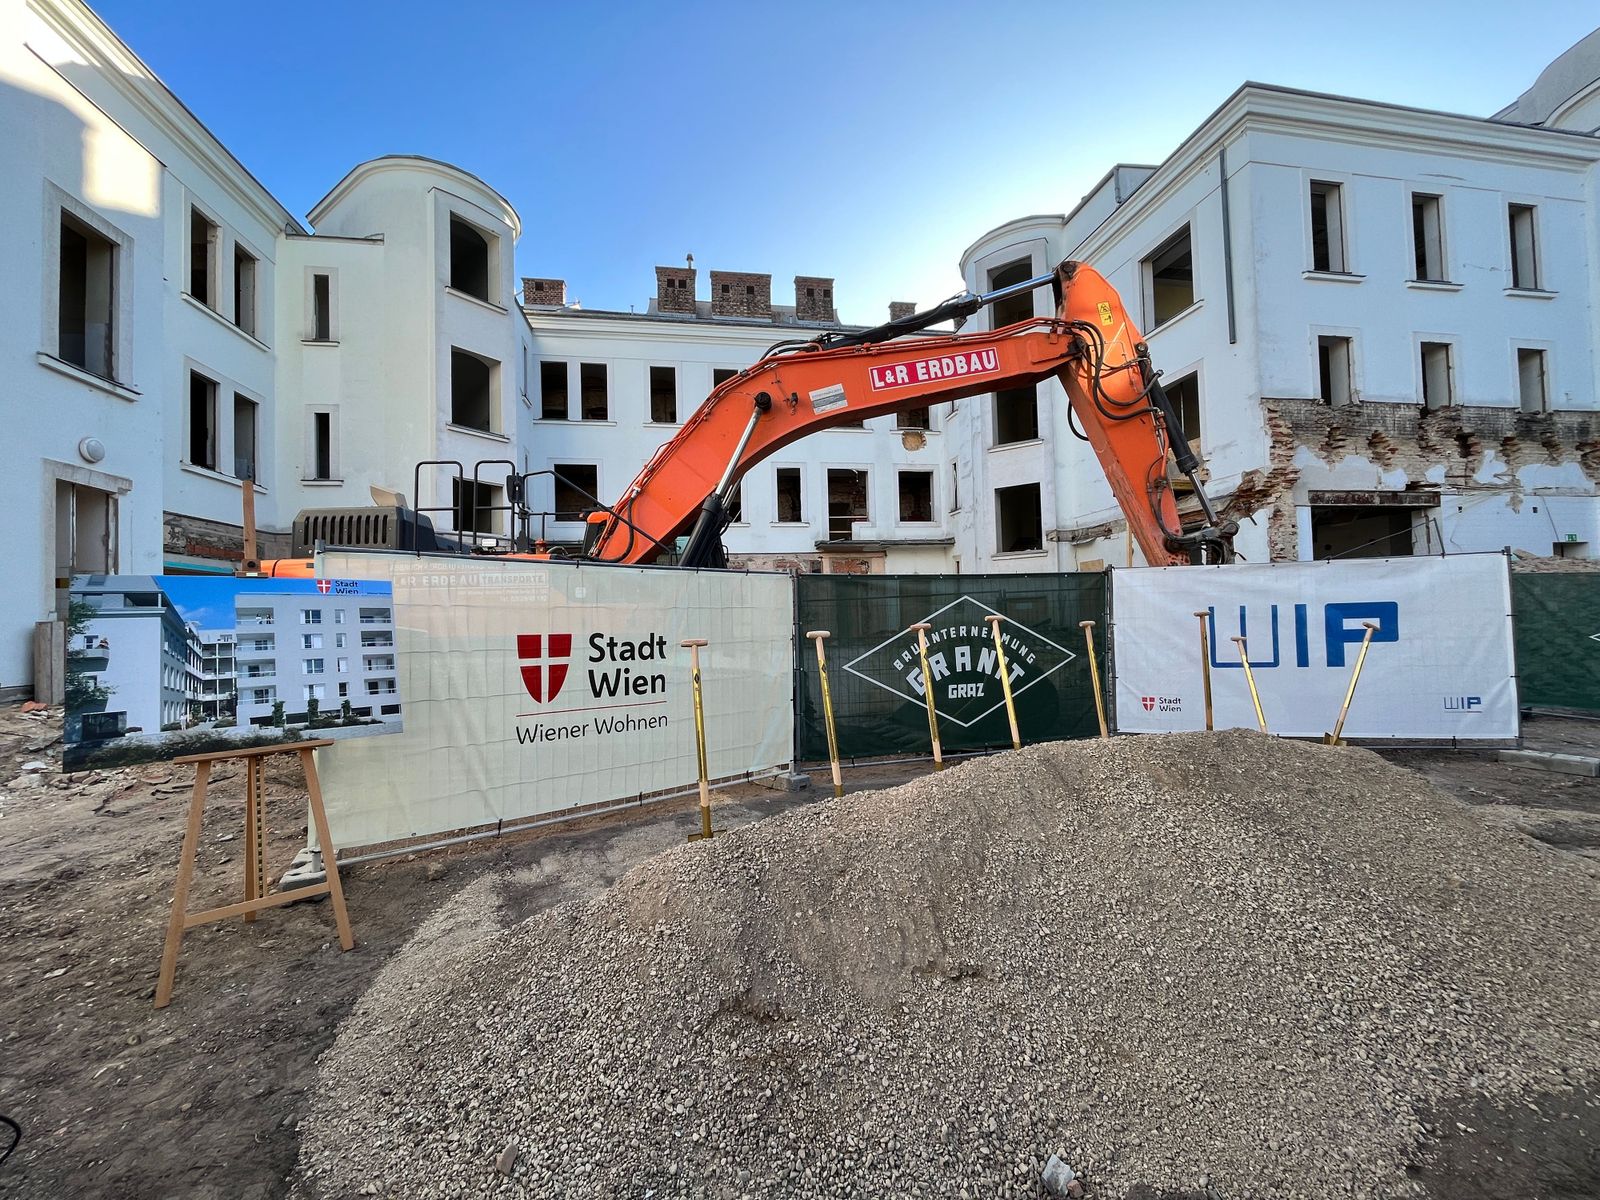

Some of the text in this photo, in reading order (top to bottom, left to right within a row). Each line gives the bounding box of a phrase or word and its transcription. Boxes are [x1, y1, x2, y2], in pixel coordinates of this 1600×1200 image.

[872, 350, 996, 387] L&R ERDBAU
[335, 580, 358, 588] Stadt
[1208, 601, 1399, 668] WIP
[588, 632, 667, 663] Stadt
[588, 667, 666, 698] Wien
[948, 682, 984, 699] GRAZ
[1159, 696, 1181, 704] Stadt
[1159, 704, 1182, 712] Wien
[1443, 696, 1481, 710] WIP
[516, 714, 668, 745] Wiener Wohnen
